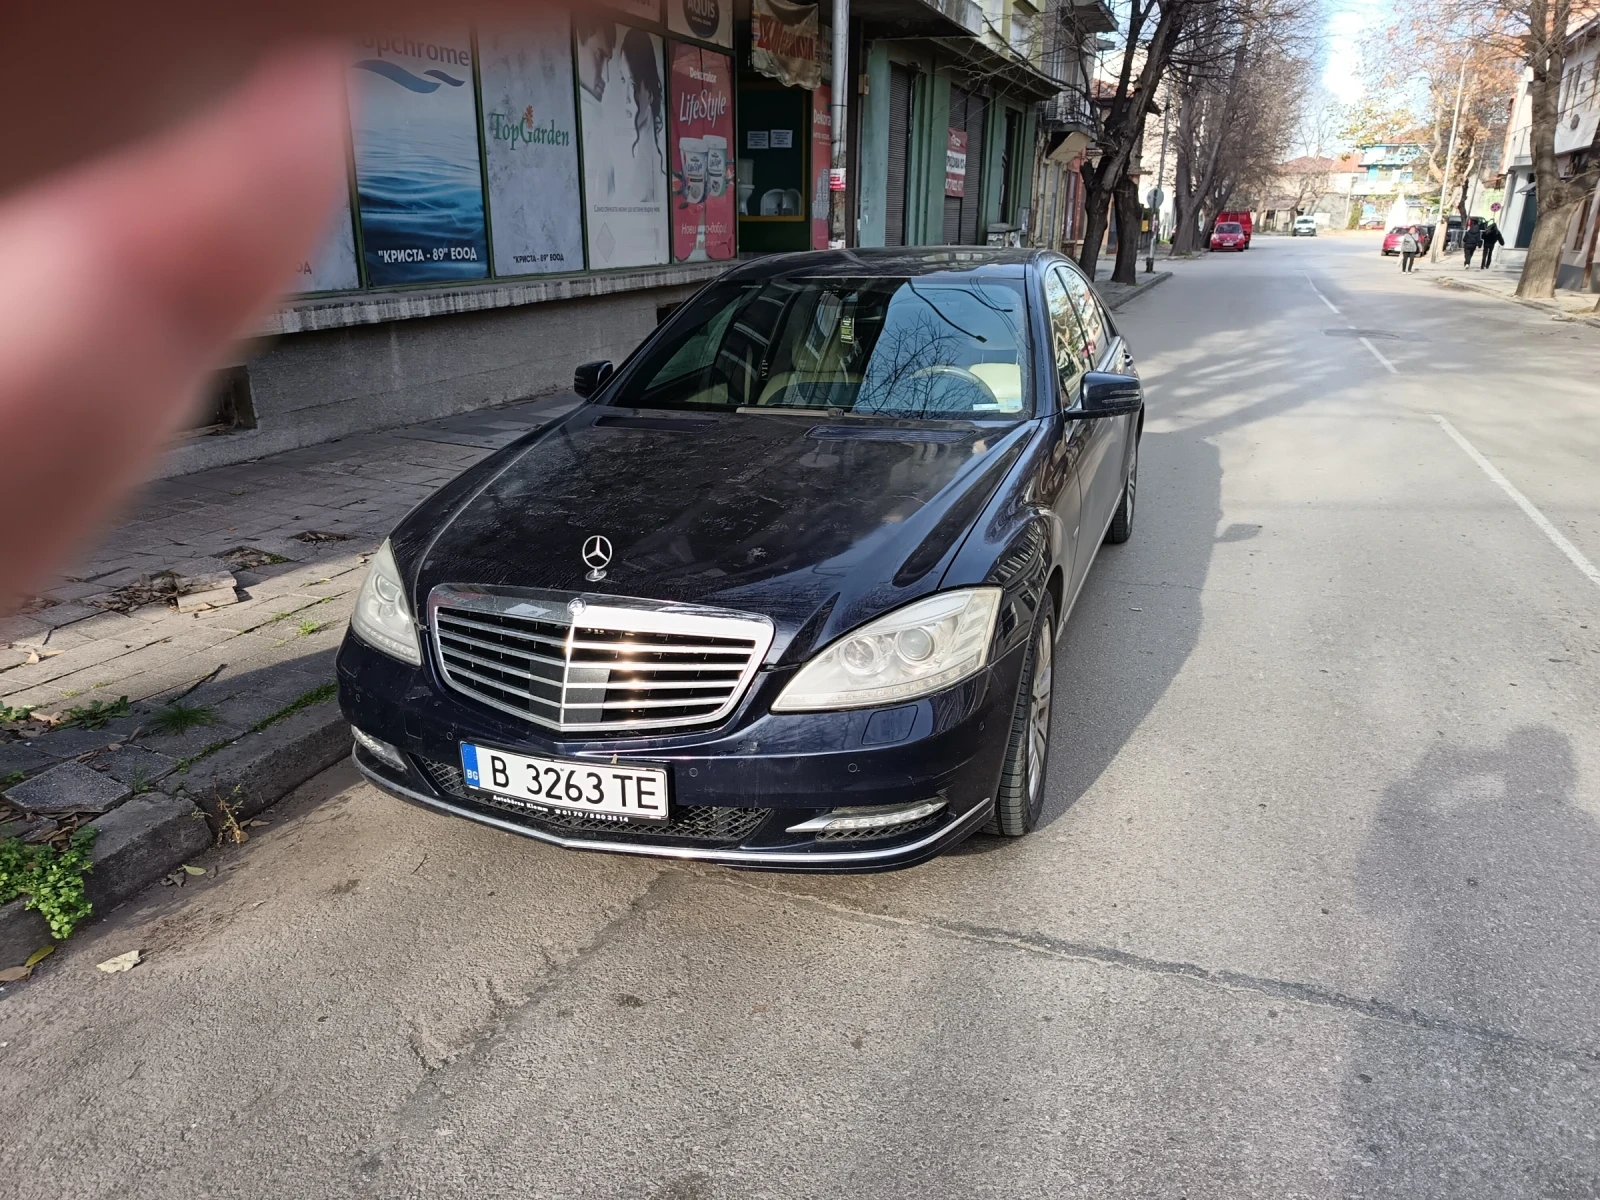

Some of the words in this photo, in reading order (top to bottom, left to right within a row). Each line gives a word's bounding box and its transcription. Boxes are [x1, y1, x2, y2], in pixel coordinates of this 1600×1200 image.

[687, 0, 716, 19] AQUIS
[356, 34, 469, 66] opchrome
[680, 89, 726, 128] LifeStyle
[813, 108, 831, 126] Dekora
[491, 112, 570, 150] TopGarden
[705, 221, 727, 235] о-добри!
[378, 249, 425, 263] "КРИСТА
[432, 248, 449, 261] 89"
[451, 247, 478, 261] ЕООД
[550, 253, 565, 262] ЕООД
[465, 768, 478, 780] BG
[490, 755, 510, 788] B
[526, 764, 605, 804] 3263
[612, 774, 659, 810] TE
